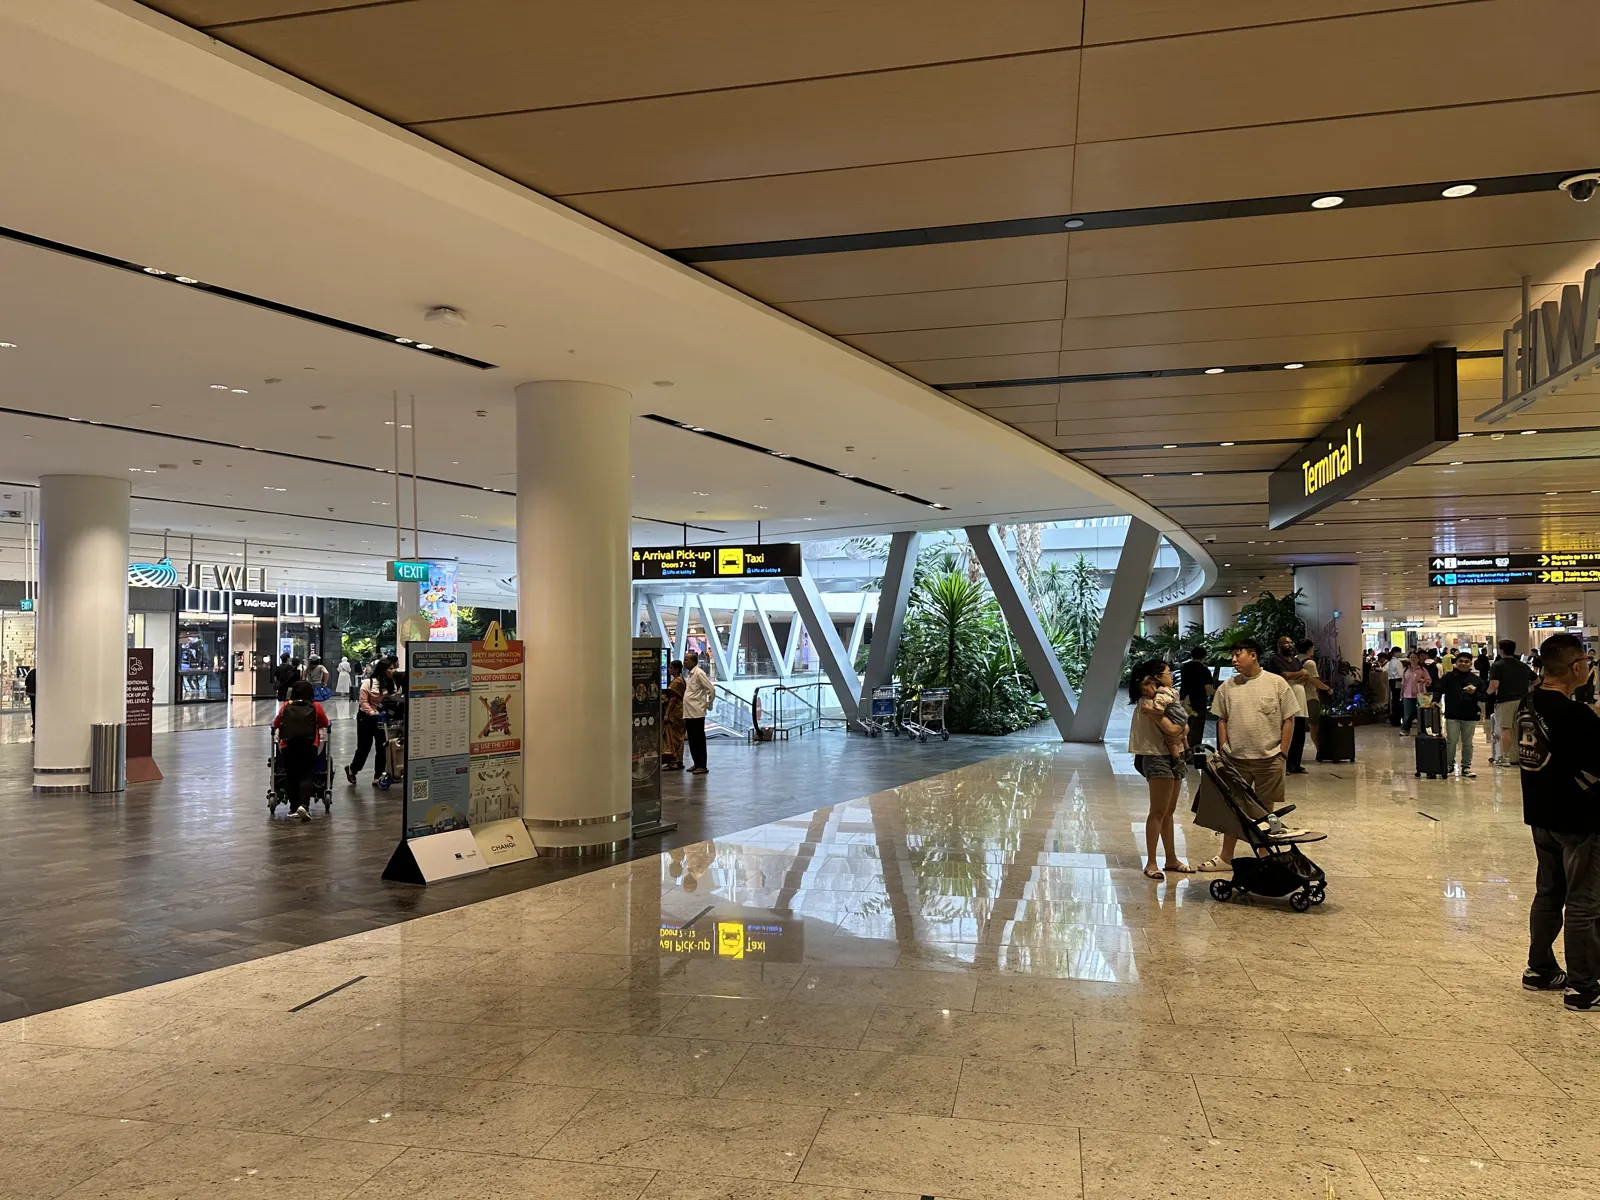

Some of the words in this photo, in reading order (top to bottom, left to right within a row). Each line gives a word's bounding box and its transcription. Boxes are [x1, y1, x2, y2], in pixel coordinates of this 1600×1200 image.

[1302, 428, 1351, 496] Terminal
[1356, 423, 1362, 465] 1
[633, 551, 640, 560] &
[643, 550, 674, 560] Arrival
[676, 549, 711, 561] Pick-up
[745, 553, 765, 563] Taxi
[181, 563, 277, 592] JEWEL
[404, 566, 424, 578] EXIT
